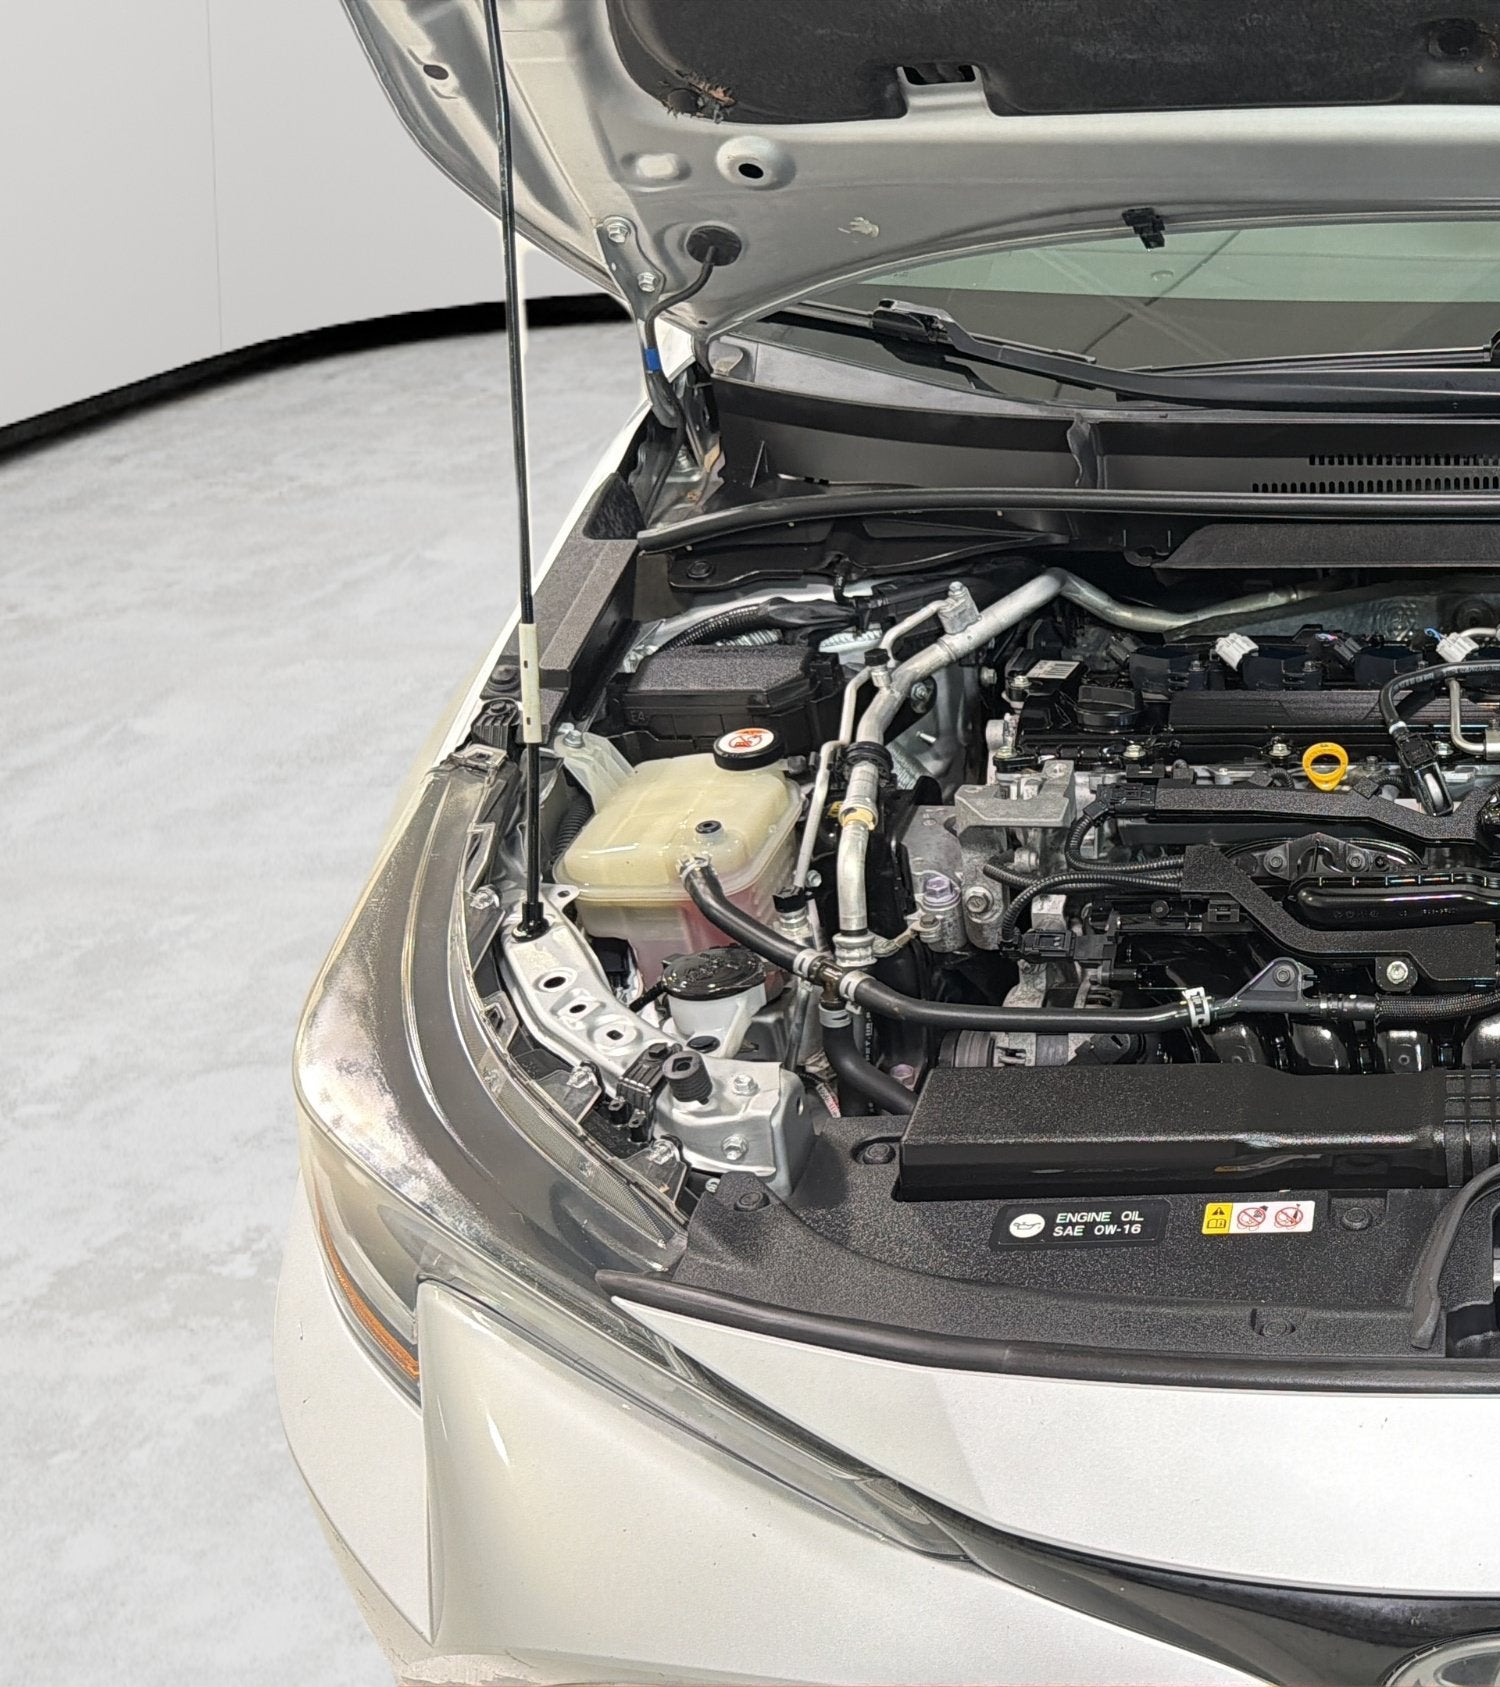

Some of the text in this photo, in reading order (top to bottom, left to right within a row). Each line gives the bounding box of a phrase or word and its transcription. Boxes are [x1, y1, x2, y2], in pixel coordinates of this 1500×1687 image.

[1056, 1210, 1144, 1222] ENGINE OIL
[1052, 1225, 1085, 1236] SAE
